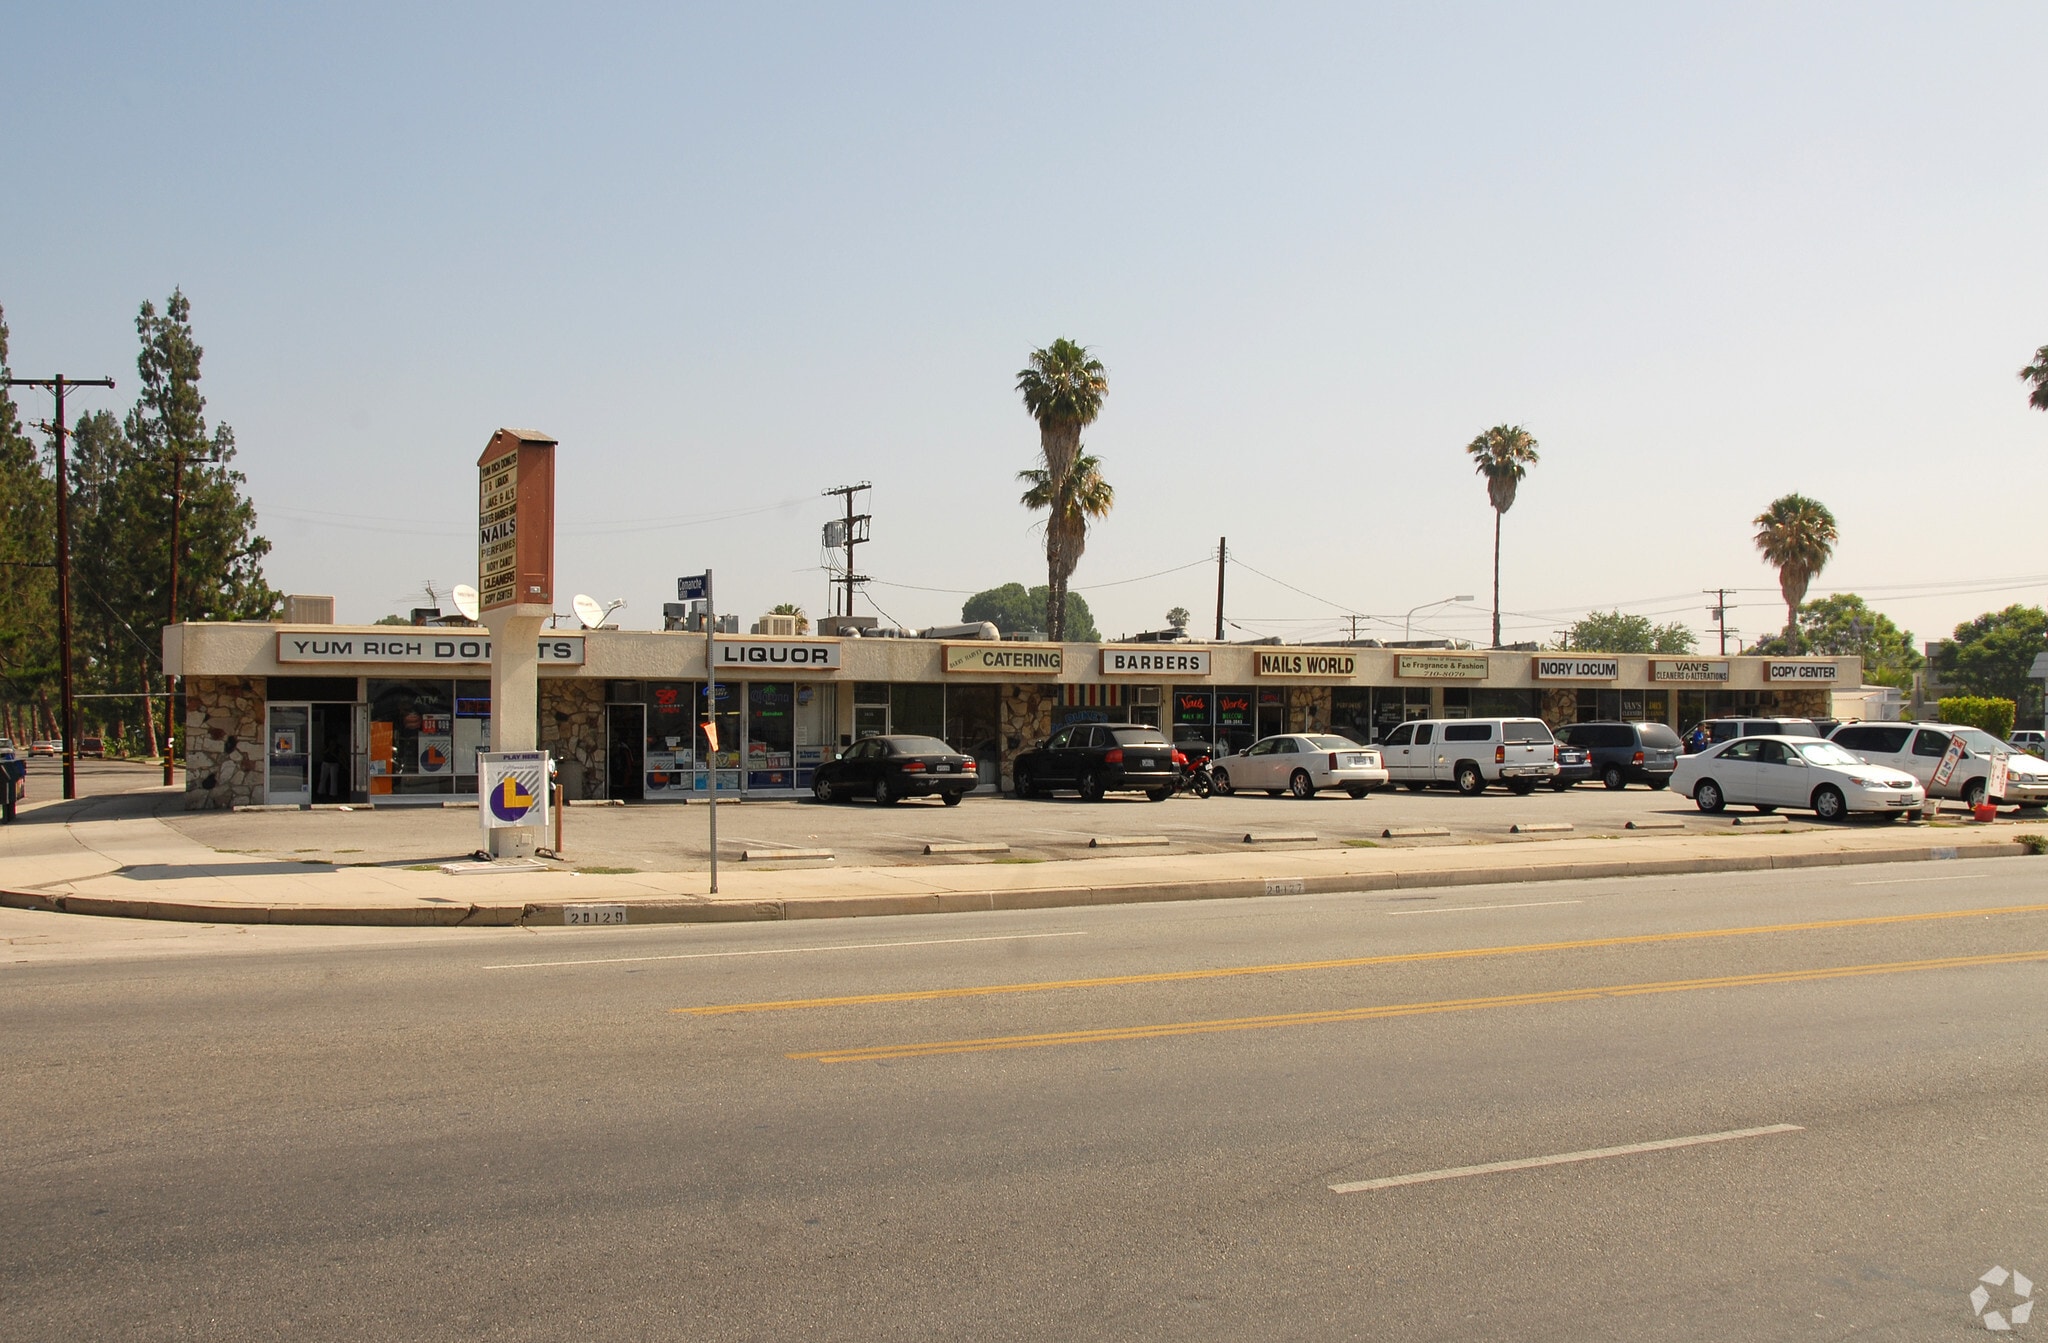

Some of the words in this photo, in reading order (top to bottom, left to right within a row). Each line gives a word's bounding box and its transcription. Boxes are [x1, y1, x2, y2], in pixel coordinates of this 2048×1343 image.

[485, 494, 498, 509] JAKE
[481, 518, 516, 544] NAILS
[481, 538, 516, 558] PERFUMES
[483, 570, 515, 590] CLEANERS
[679, 577, 702, 591] Comanche
[484, 592, 496, 605] COPY
[497, 587, 513, 602] CENTER
[293, 641, 352, 655] YUM
[363, 642, 422, 656] RICH
[434, 641, 572, 659] DOTS
[724, 646, 828, 663] LIQUOR
[982, 651, 1061, 668] CATERING
[1115, 655, 1200, 670] BARBERS
[1261, 655, 1301, 674] NAILS
[1306, 656, 1354, 674] WORLD
[1412, 661, 1448, 670] Fragrance
[1457, 662, 1484, 670] Fashion
[1675, 662, 1709, 672] VAN'S
[1540, 662, 1573, 675] NORY
[1576, 662, 1616, 676] LOCUM
[1656, 671, 1685, 680] CLEANERS
[1690, 672, 1727, 681] ALTERATIONS
[1771, 666, 1797, 677] COPY
[1799, 666, 1835, 678] CENTER
[414, 695, 439, 705] ATM
[1181, 694, 1205, 710] Nails
[1221, 696, 1248, 711] World
[1623, 701, 1642, 710] VAN'S
[1939, 738, 1964, 778] NAILS
[571, 911, 623, 924] 20129
